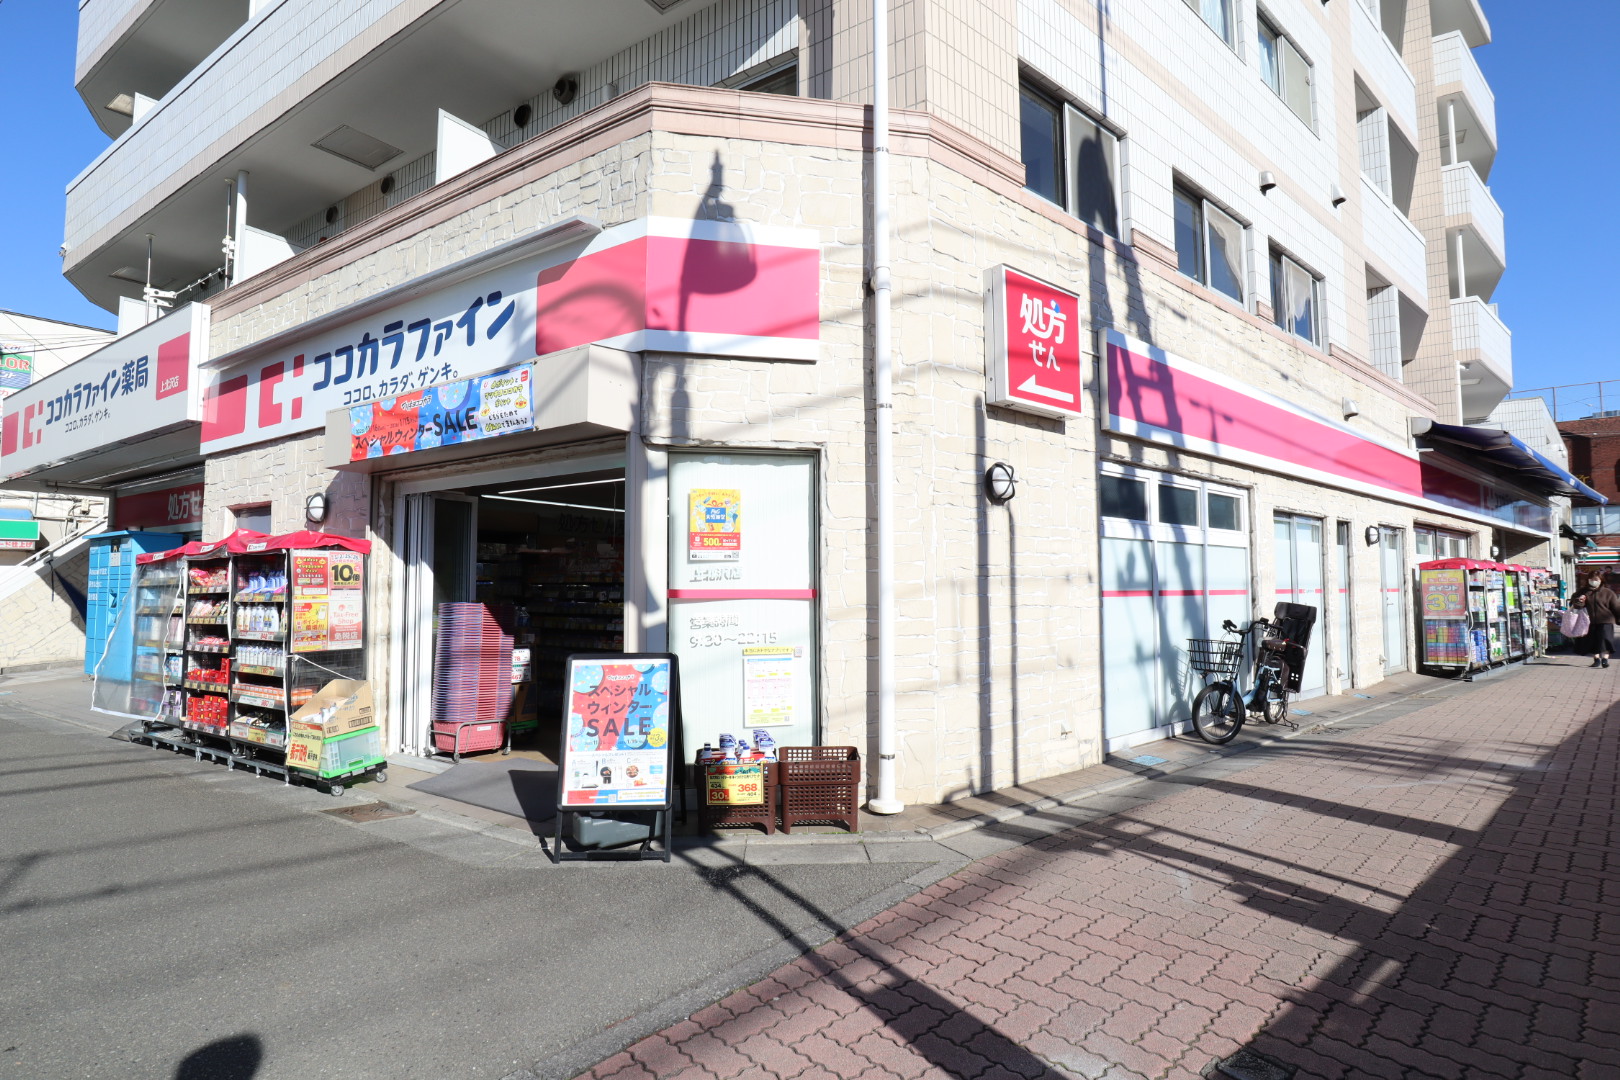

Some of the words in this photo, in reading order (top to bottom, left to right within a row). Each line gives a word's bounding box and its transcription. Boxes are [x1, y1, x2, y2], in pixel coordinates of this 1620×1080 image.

[1020, 293, 1067, 344] 処方
[313, 290, 515, 391] ココカラファイン
[1028, 340, 1061, 372] せん
[45, 355, 149, 425] ココカラファイン薬局
[159, 375, 180, 393] 上北沢店
[343, 364, 458, 405] ココロ、カラダ、ゲンキ。
[588, 683, 652, 698] スペシャル
[587, 699, 653, 715] ウィンター
[586, 716, 651, 738] SALE
[737, 783, 758, 792] 368
